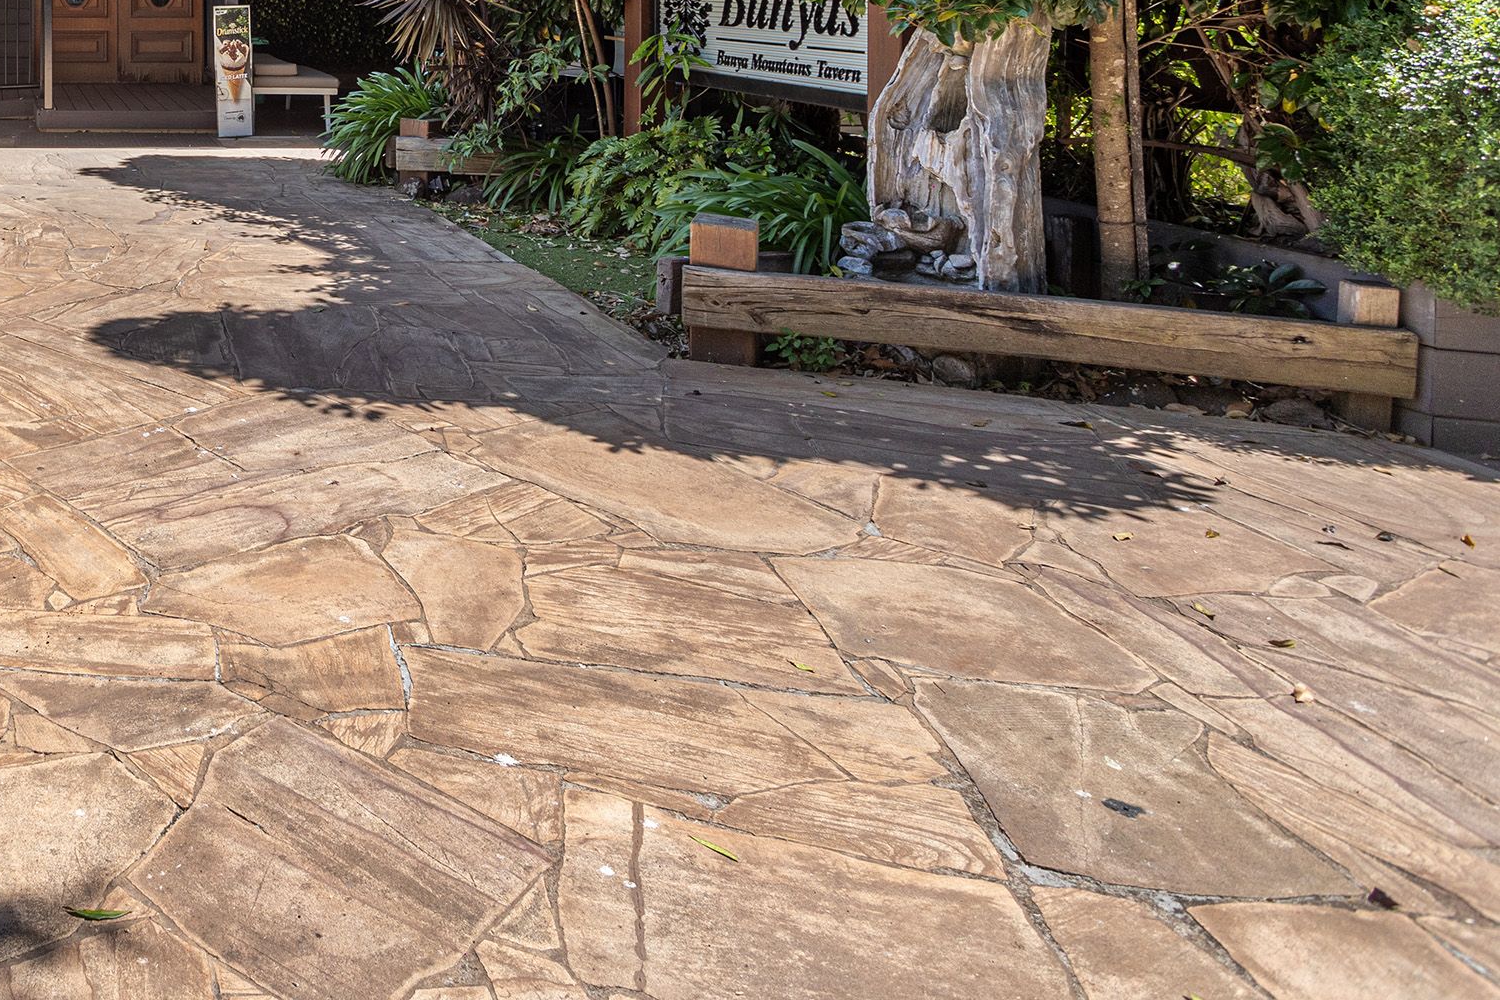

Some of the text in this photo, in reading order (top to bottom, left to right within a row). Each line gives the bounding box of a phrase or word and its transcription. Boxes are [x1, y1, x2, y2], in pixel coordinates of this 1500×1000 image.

[716, 50, 861, 83] Bunya Mountains Tavern
